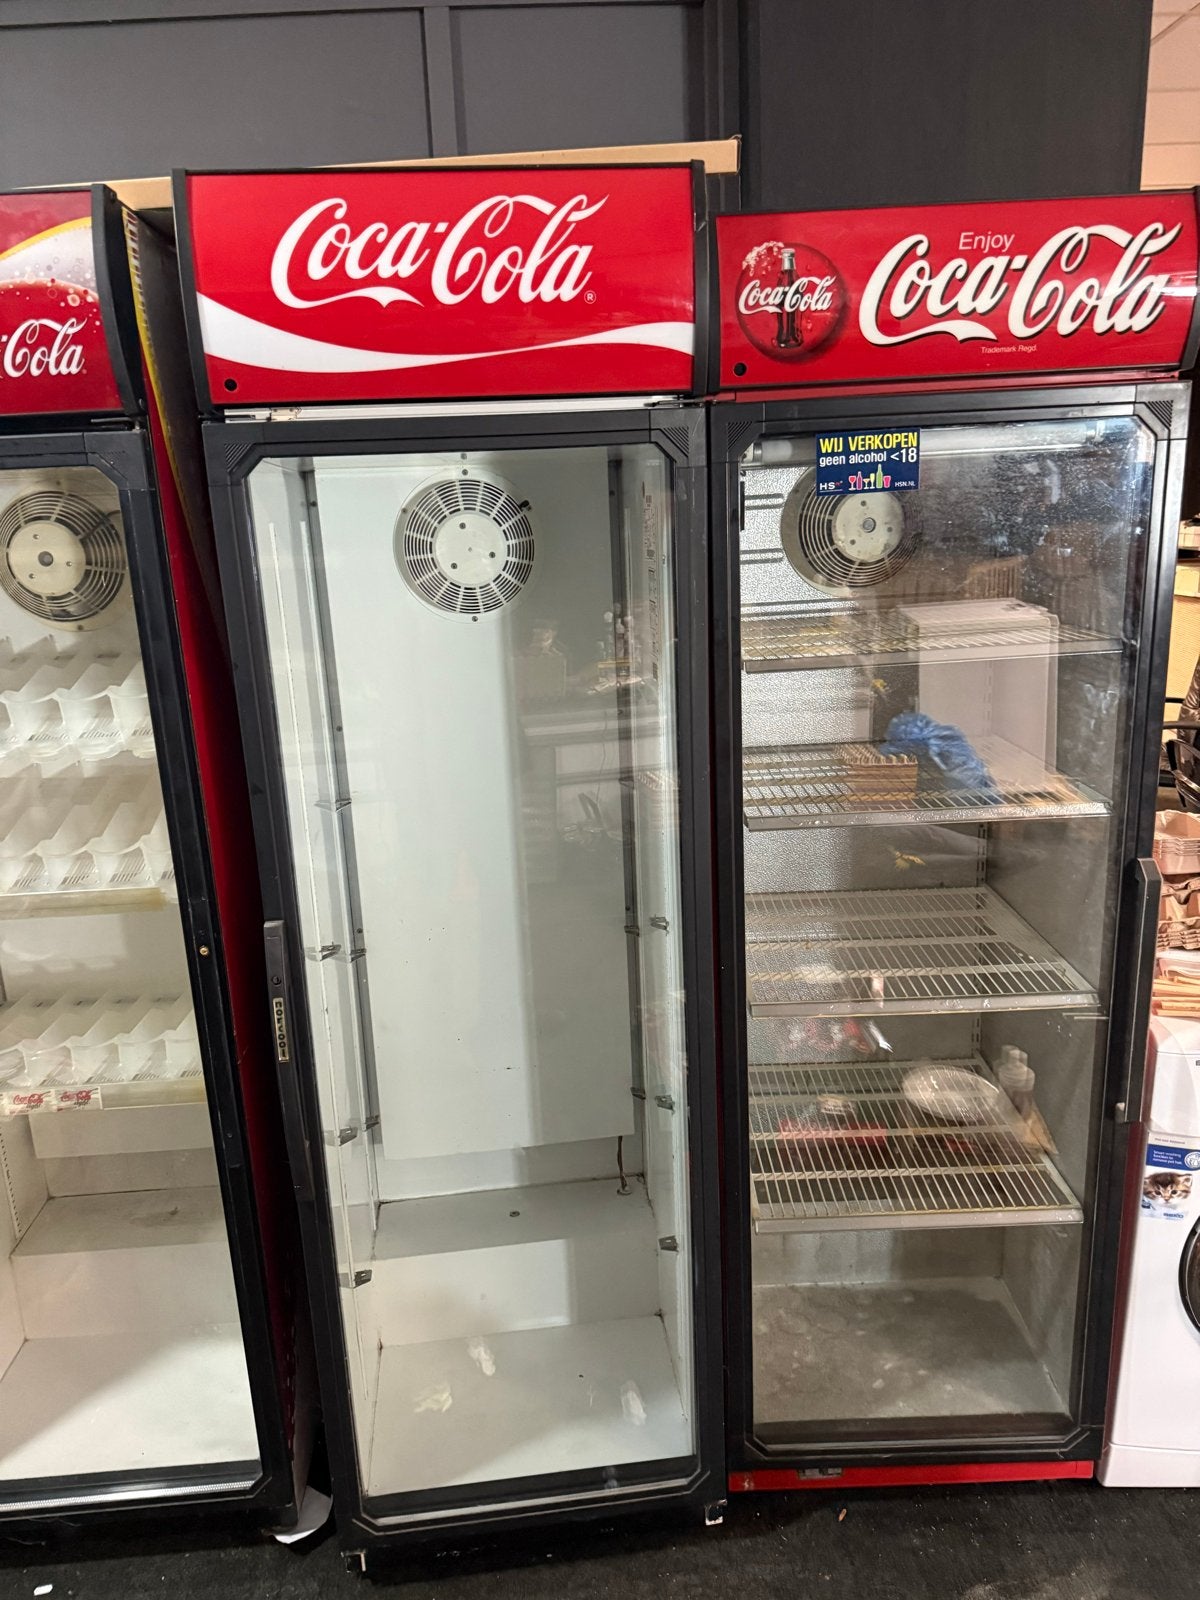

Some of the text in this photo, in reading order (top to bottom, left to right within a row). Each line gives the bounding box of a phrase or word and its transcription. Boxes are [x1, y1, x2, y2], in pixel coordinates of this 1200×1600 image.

[271, 194, 609, 309] Coca-Cola
[959, 232, 1015, 252] Enjoy
[739, 276, 836, 314] Coca-Cola
[859, 222, 1182, 345] Coca-Cola
[819, 447, 917, 467] geen alcohol <18
[820, 432, 917, 453] WIJ VERKOPEN
